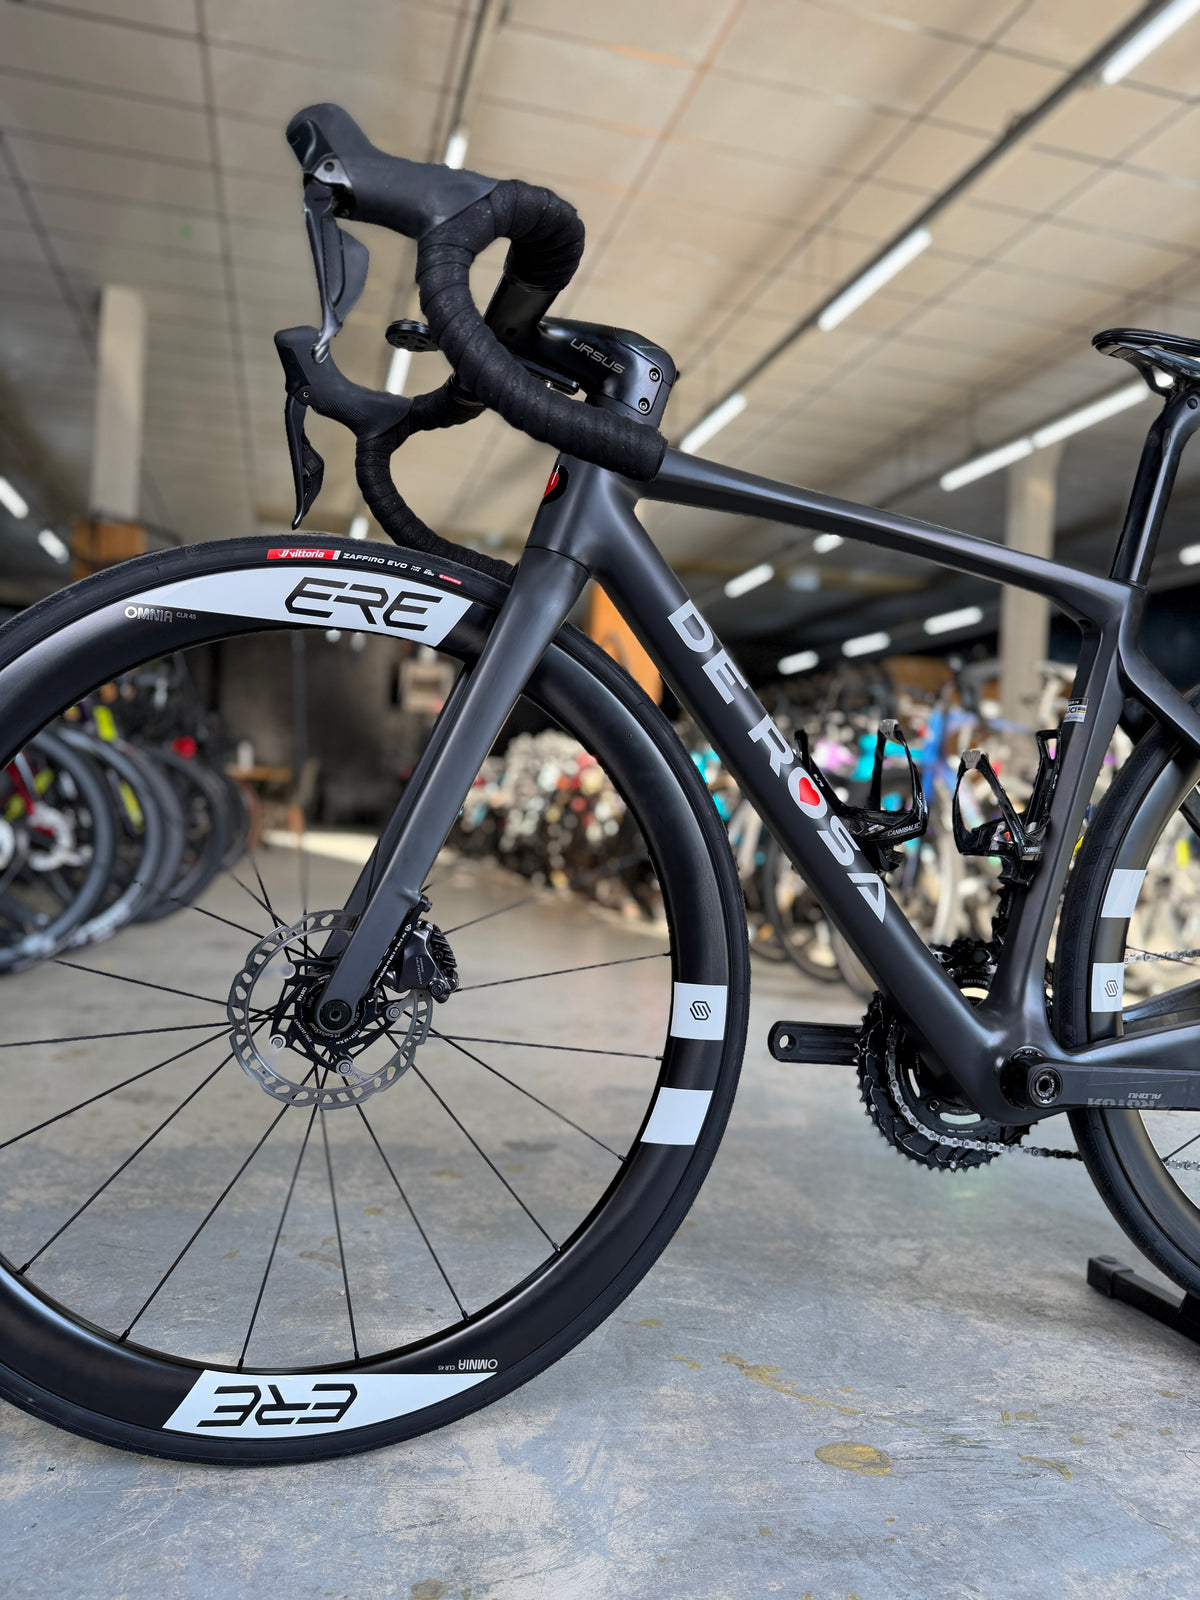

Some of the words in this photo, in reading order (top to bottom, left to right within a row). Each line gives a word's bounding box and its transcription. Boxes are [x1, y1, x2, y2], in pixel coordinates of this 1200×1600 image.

[570, 338, 626, 374] URSUS
[289, 549, 326, 558] vittoria
[342, 552, 385, 564] ZAFFIRO
[386, 560, 408, 569] EVO
[124, 606, 173, 622] OMNIA
[176, 611, 188, 619] CLR
[285, 576, 443, 632] ERE
[668, 599, 749, 704] DE
[747, 714, 887, 923] ROSA
[458, 1358, 498, 1370] OMNIA
[196, 1383, 358, 1427] ERE
